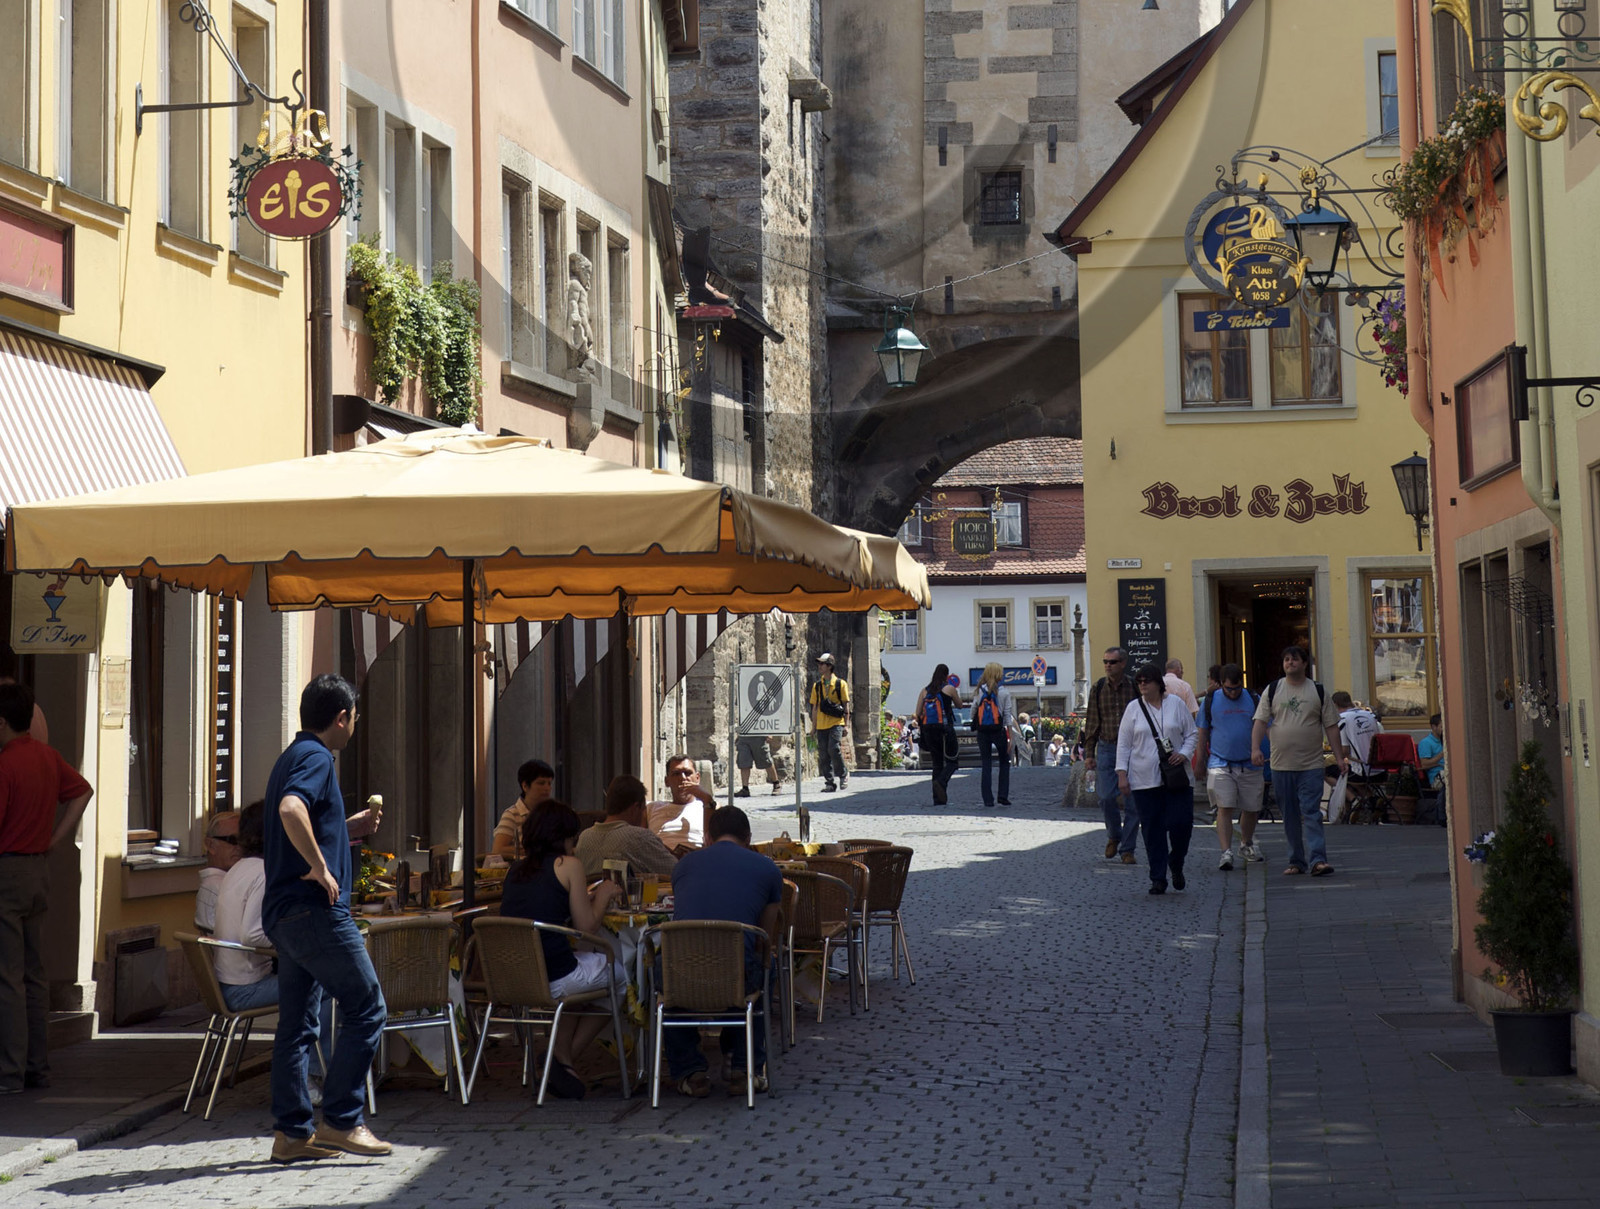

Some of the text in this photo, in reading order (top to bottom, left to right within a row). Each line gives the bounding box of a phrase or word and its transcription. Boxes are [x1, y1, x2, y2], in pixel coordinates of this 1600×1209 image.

[1232, 243, 1292, 257] Kunstgewerbe
[1251, 265, 1273, 275] Klaus
[1246, 277, 1278, 290] Abt
[1251, 291, 1270, 301] 1658
[1140, 473, 1370, 523] Brot & Zeit
[1125, 622, 1161, 630] PASTA
[753, 719, 779, 730] ZONE
